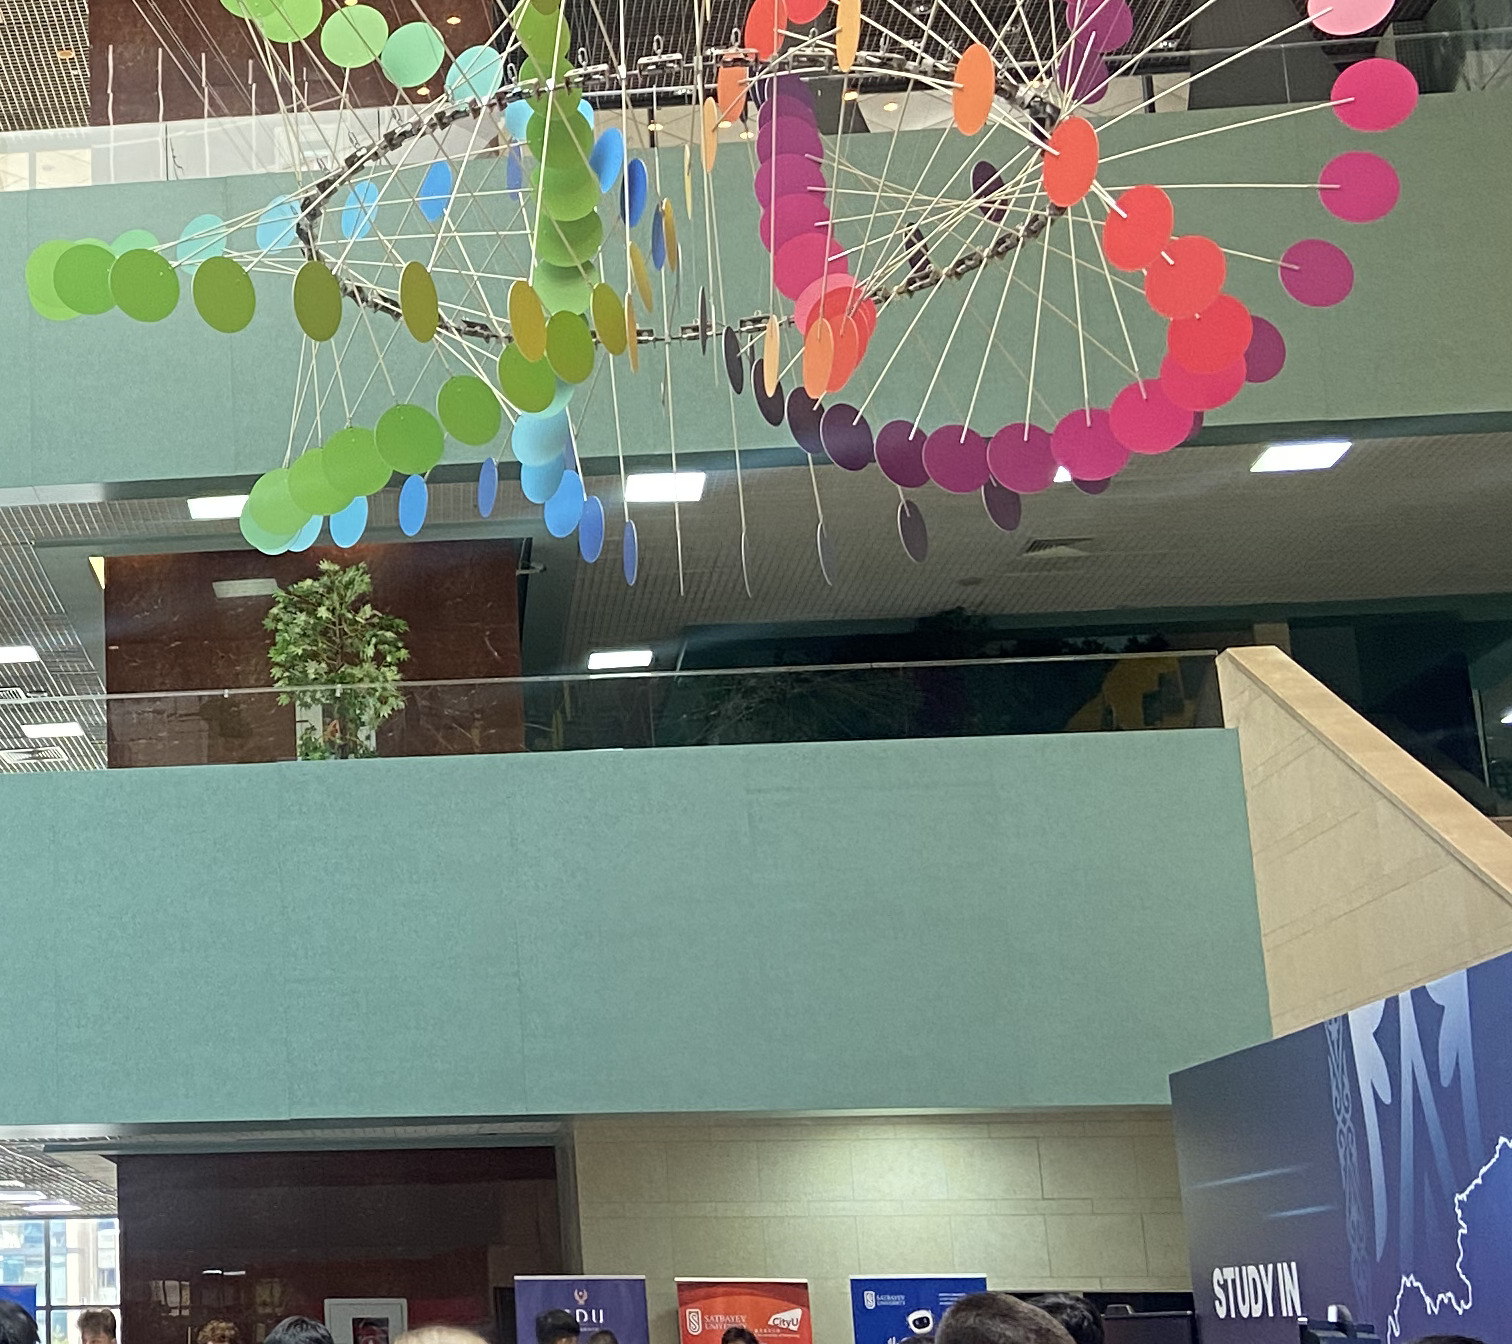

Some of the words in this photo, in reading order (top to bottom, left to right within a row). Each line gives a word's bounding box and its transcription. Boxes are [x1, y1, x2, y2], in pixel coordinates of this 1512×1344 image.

[1213, 1264, 1273, 1318] STUDY
[1277, 1262, 1301, 1316] IN
[565, 1309, 603, 1323] DU
[704, 1315, 747, 1323] SATBAYEV
[773, 1317, 799, 1328] CityU
